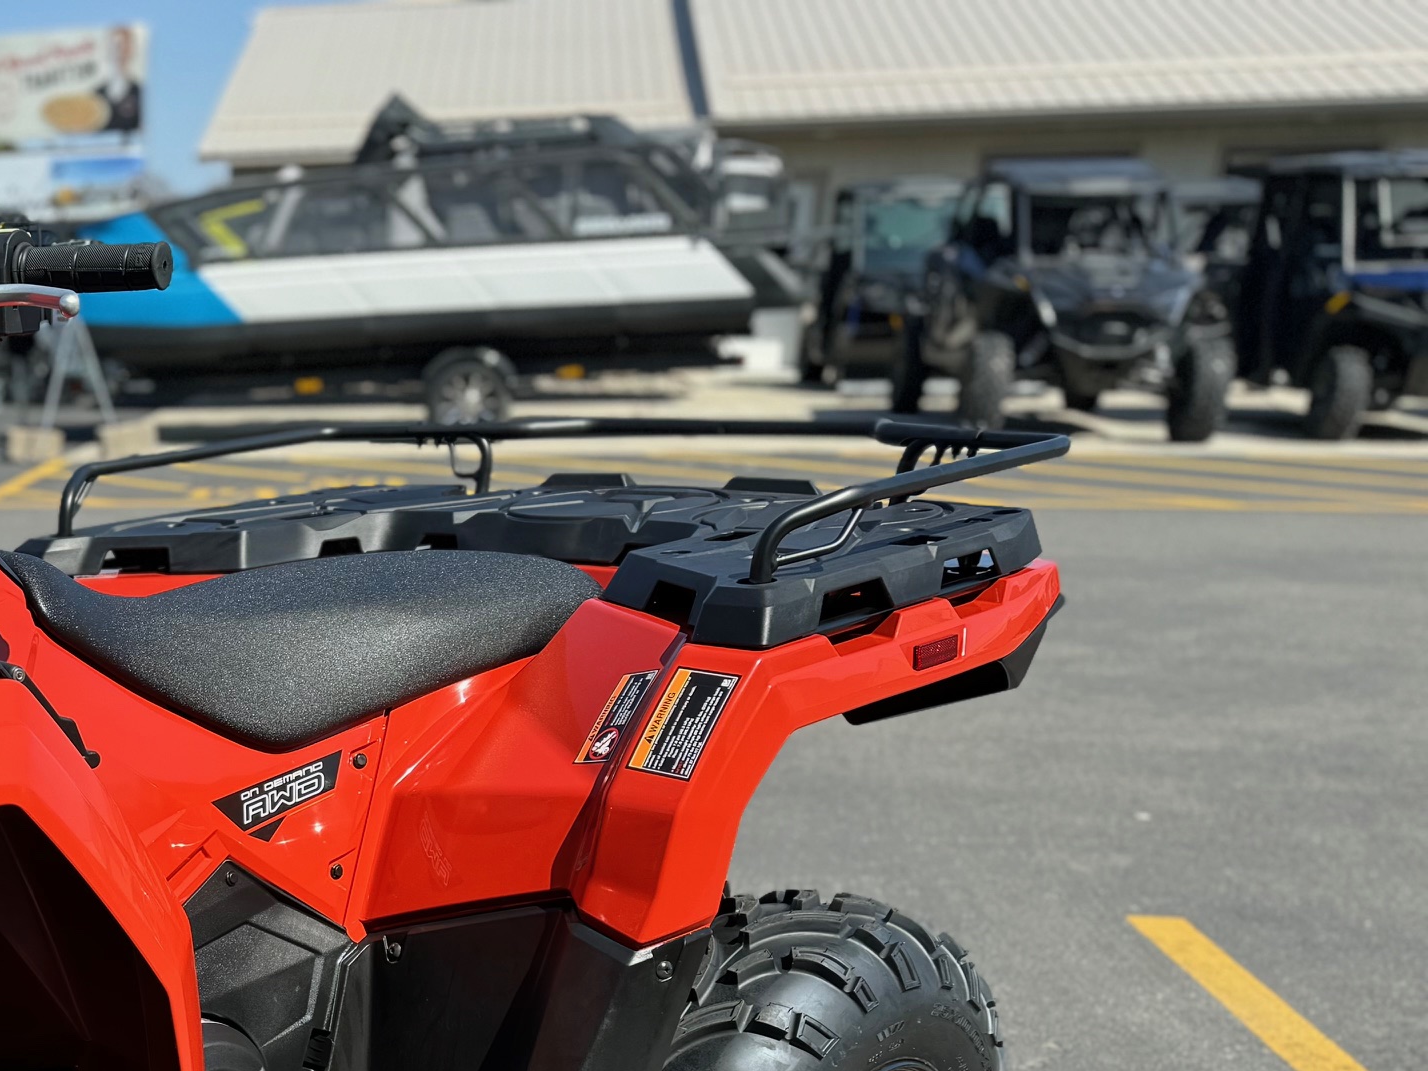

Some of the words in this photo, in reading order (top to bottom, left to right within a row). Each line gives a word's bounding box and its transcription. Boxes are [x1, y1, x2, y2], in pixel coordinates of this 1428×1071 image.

[648, 691, 675, 732] WARNING
[240, 787, 259, 801] ON
[264, 761, 323, 792] DEMAND
[243, 771, 325, 825] AWD
